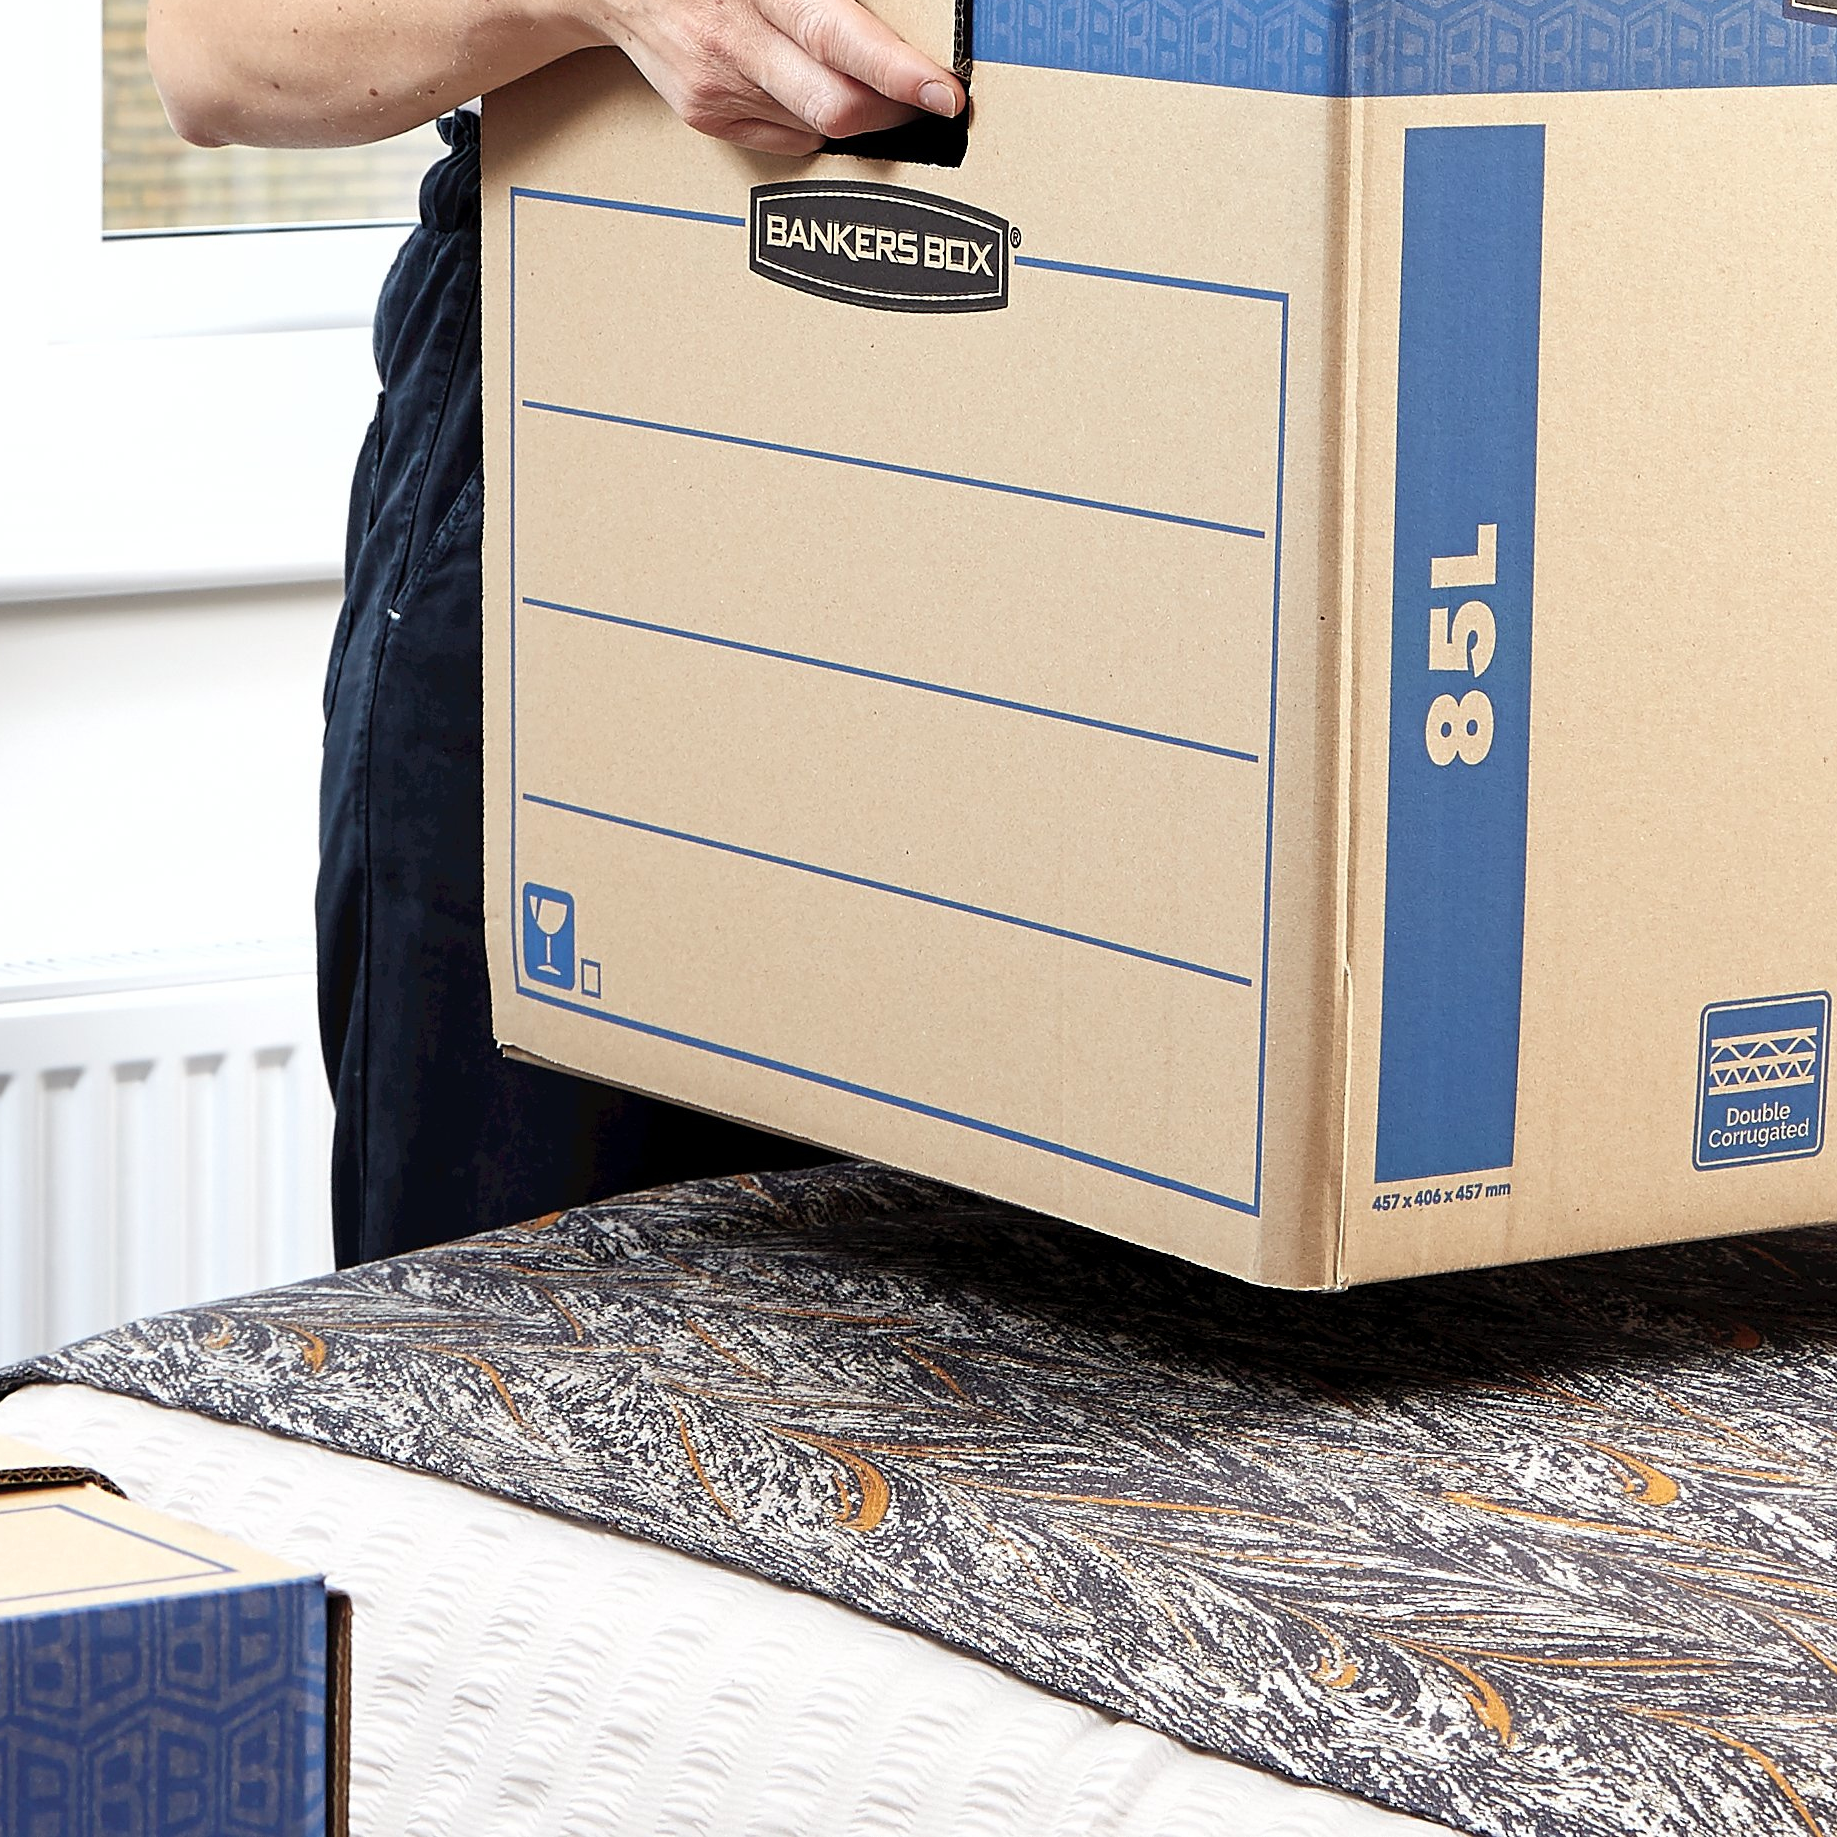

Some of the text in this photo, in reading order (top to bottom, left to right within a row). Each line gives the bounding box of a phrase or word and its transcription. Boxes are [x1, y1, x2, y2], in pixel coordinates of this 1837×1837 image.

[766, 213, 918, 266] BANKERS
[1425, 523, 1498, 767] 85L
[1727, 1102, 1791, 1128] Double
[1708, 1118, 1809, 1149] Corrugated
[1372, 1194, 1400, 1211] 457
[1414, 1188, 1442, 1206] 406
[1456, 1183, 1483, 1201] 457
[1485, 1182, 1511, 1198] mm
